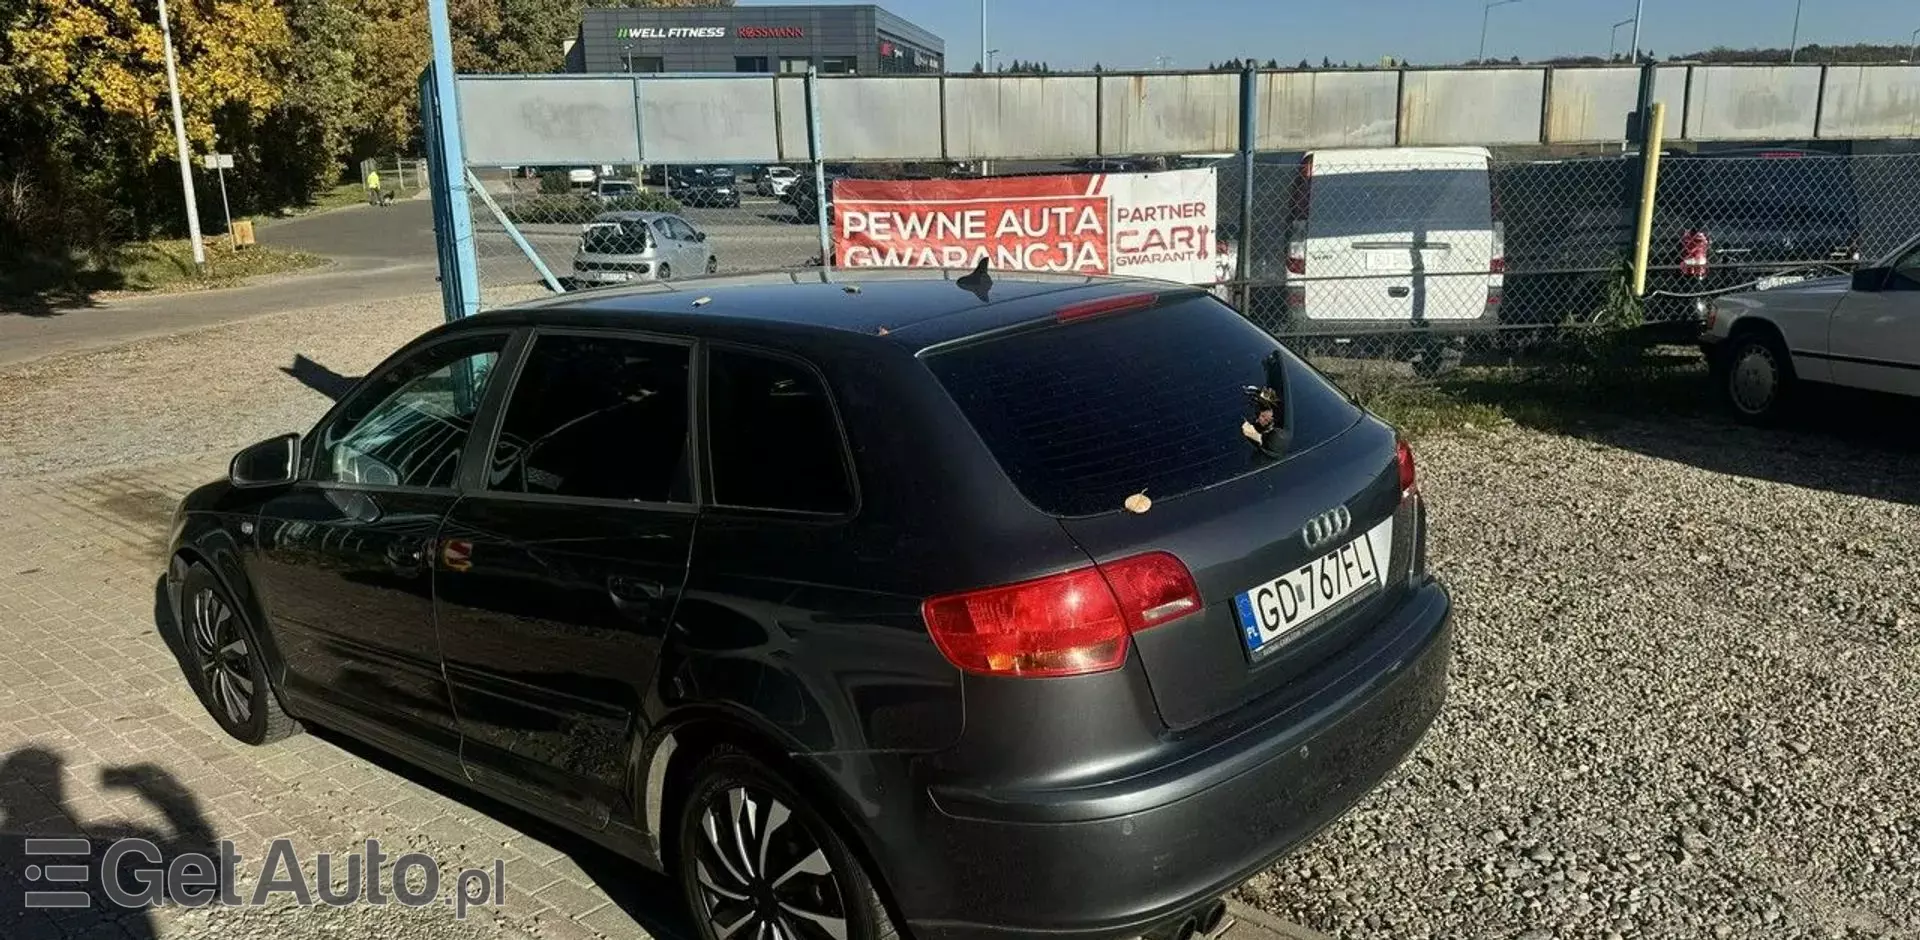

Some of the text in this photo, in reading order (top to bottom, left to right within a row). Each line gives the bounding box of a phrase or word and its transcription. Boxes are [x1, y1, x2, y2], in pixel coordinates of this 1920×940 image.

[629, 27, 725, 38] WELL FITNESS
[736, 26, 804, 38] ROSSMANN
[843, 205, 1104, 240] PEWNE AUTA
[1117, 202, 1206, 222] PARTNER
[1116, 226, 1194, 253] CAR
[845, 242, 1105, 271] GWARANCJA
[1116, 250, 1195, 266] GWARANT
[1257, 579, 1298, 632] GD
[1300, 541, 1371, 610] 767FL
